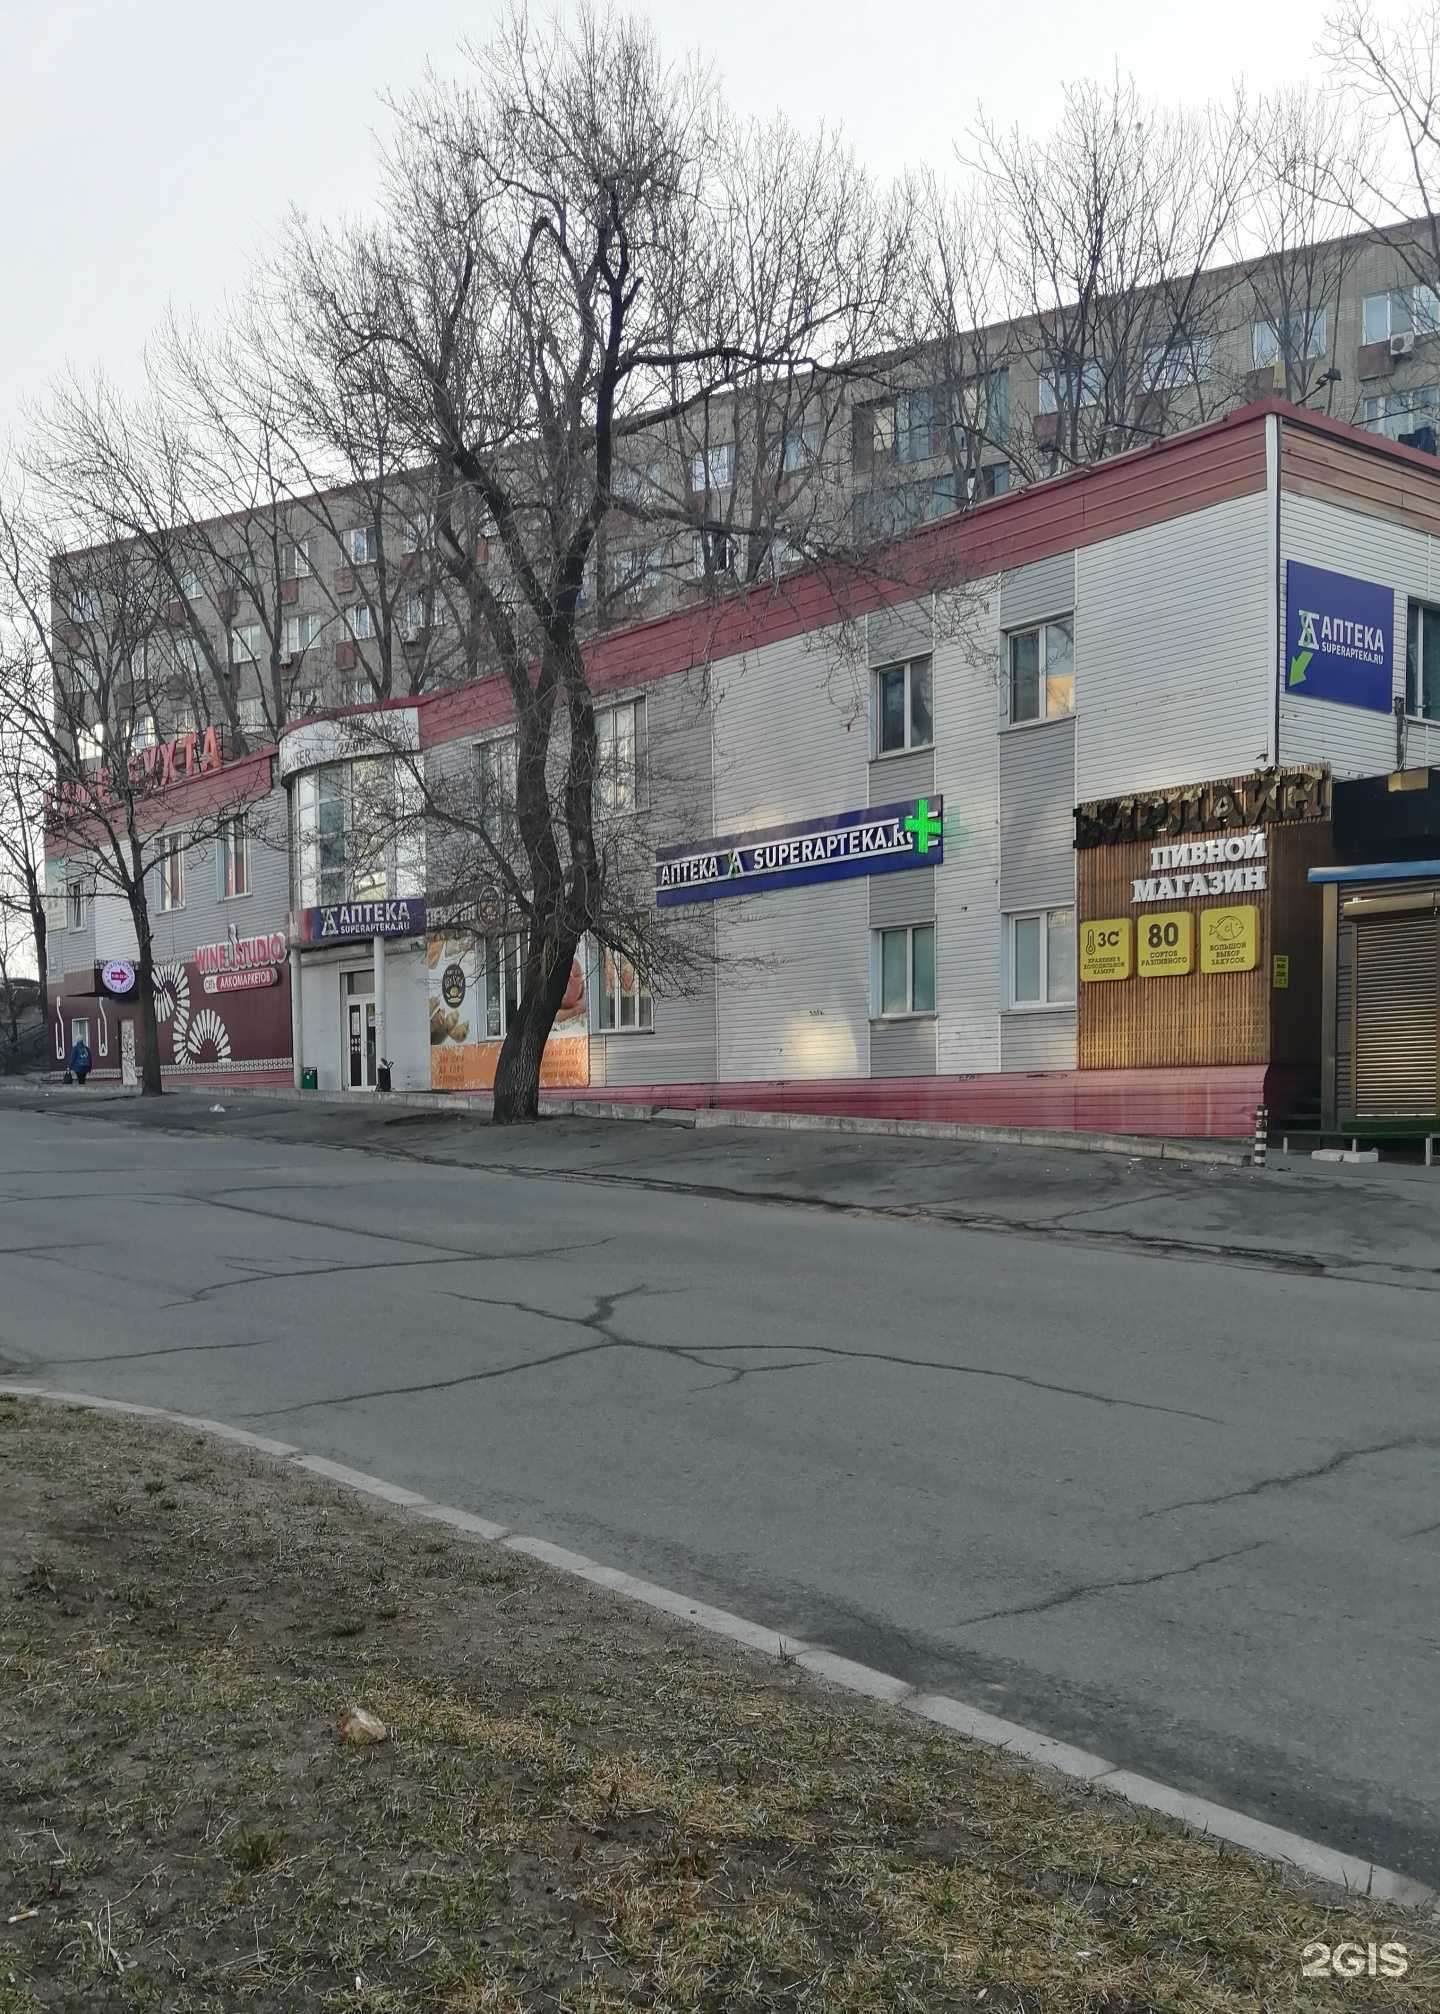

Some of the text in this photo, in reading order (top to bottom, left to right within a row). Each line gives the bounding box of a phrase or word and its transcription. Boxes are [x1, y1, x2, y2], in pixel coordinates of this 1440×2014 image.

[1321, 616, 1384, 652] АПТЕКА
[1322, 642, 1384, 665] SUPERAPTEKA.RU
[1151, 829, 1267, 870] ПИВНОЙ
[661, 856, 719, 885] АПТЕКА
[1130, 866, 1267, 903] МАГАЗИН
[340, 901, 411, 924] АПТЕКА
[340, 921, 410, 935] SUPERAPTEKA.RU
[1148, 922, 1179, 948] 80
[196, 931, 287, 975] WINE STUDIO
[1150, 950, 1178, 958] СОРТОВ
[1210, 942, 1246, 951] БОЛЬШОЙ
[1216, 950, 1240, 958] ВЫБОР
[1141, 957, 1187, 967] РАЗЛИВНОГО
[1211, 956, 1245, 966] ЗАКУСОК
[220, 971, 271, 990] АЛКОМАРКЕТОВ
